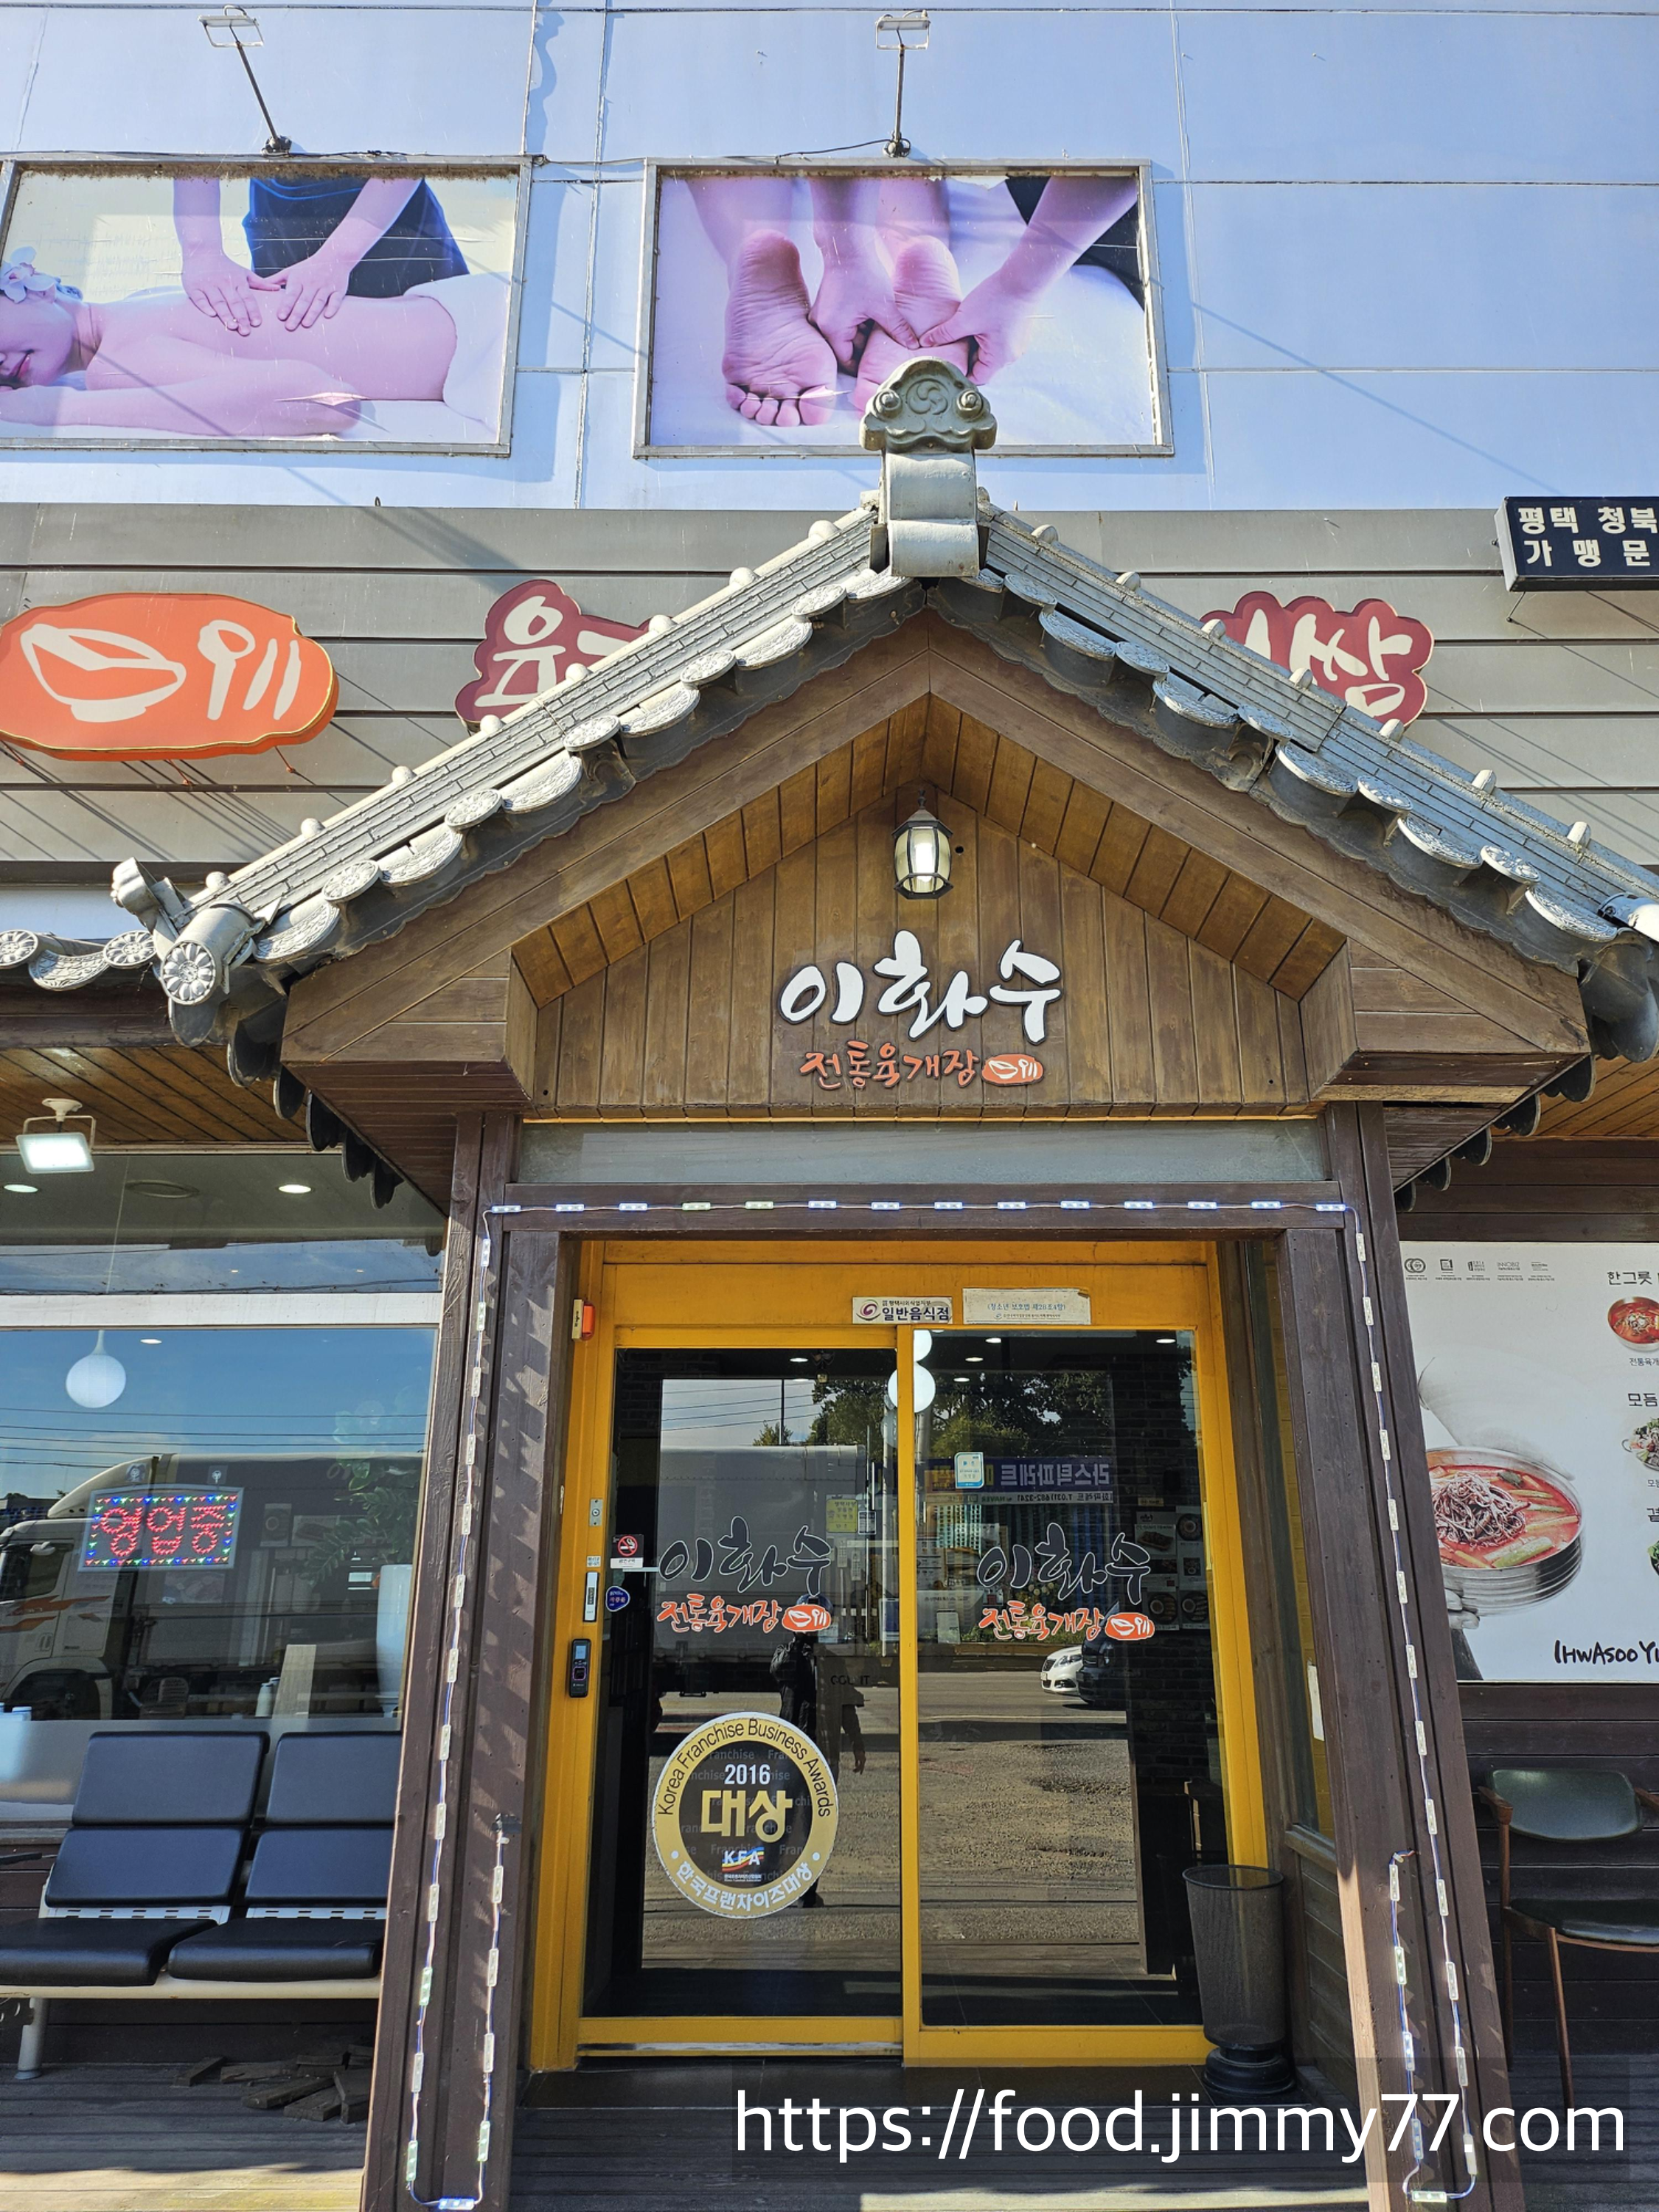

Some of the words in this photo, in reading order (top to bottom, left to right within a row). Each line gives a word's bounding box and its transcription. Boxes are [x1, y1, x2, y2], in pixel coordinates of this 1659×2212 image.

[1517, 507, 1579, 535] 평택
[1598, 507, 1658, 535] 청북
[779, 930, 1062, 1046] 이화수
[799, 1040, 980, 1091] 전통육개장
[1607, 1271, 1653, 1286] 한그릇
[882, 1307, 950, 1321] 일반음식점
[100, 1506, 228, 1557] 영업중
[659, 1515, 832, 1597] 이화수
[977, 1522, 1151, 1605] 이화수
[656, 1593, 783, 1632] 전통육개장
[978, 1600, 1105, 1641] 전통육개장
[657, 1768, 686, 1815] Korea
[676, 1722, 745, 1770] Franchise
[748, 1718, 808, 1761] Business
[802, 1758, 834, 1818] Awards
[723, 1763, 771, 1785] 2016
[700, 1790, 793, 1843] 대상
[675, 1860, 813, 1912] 한국프랜차이즈대상
